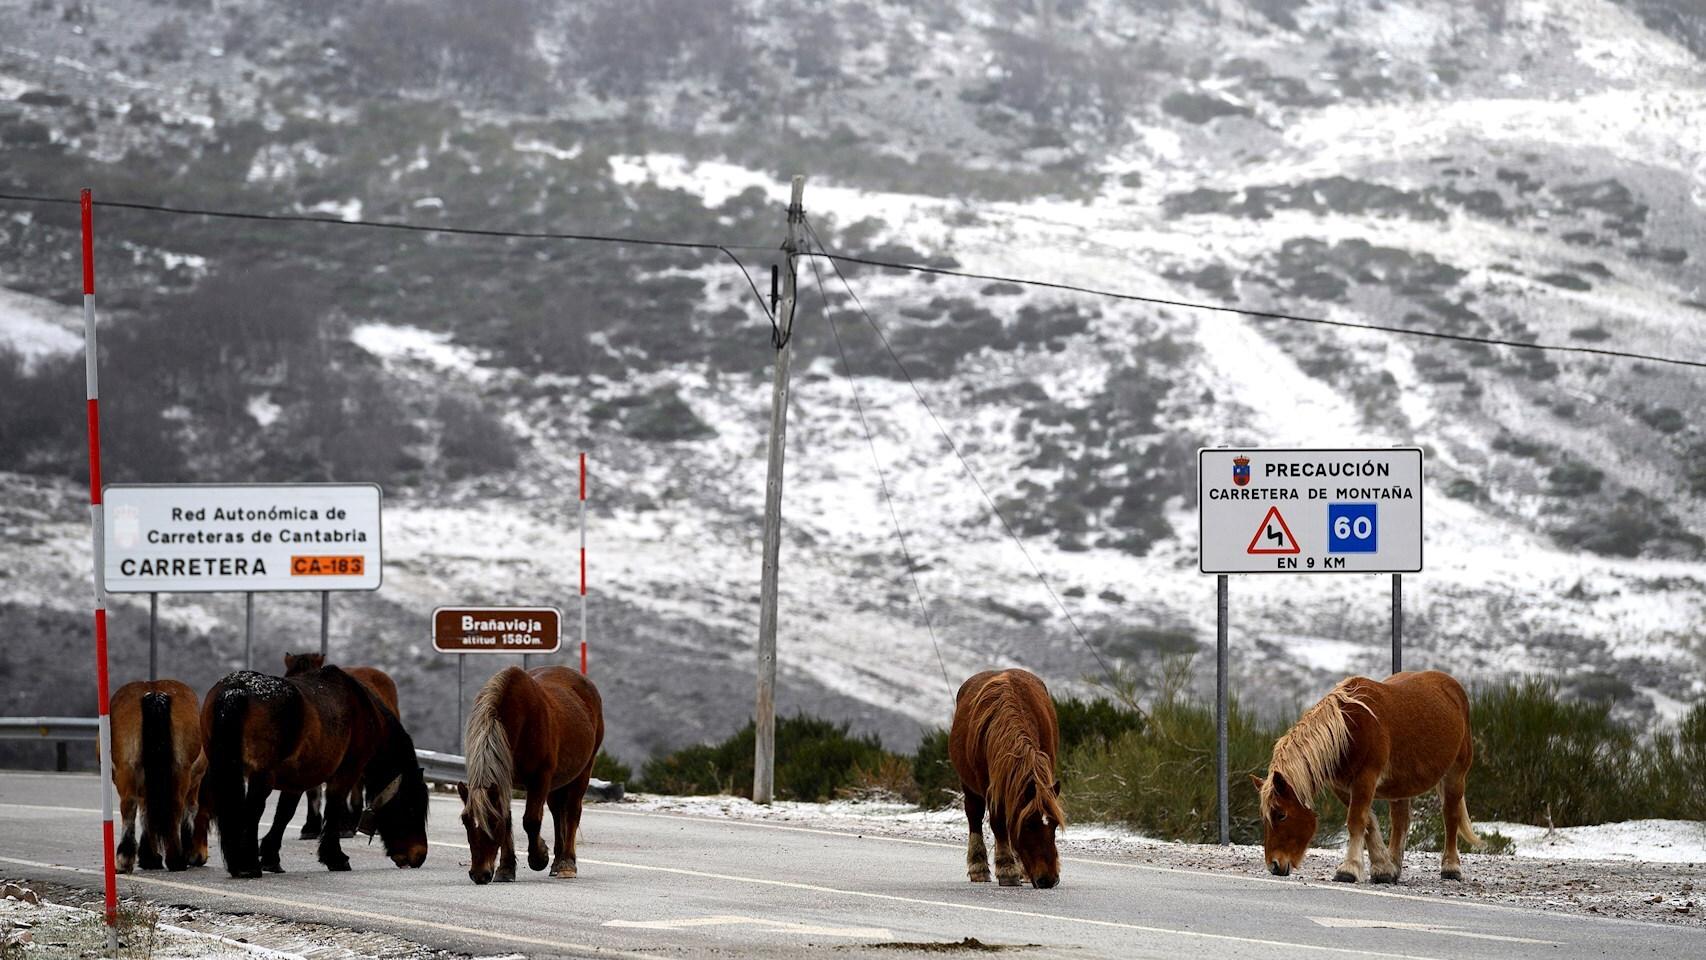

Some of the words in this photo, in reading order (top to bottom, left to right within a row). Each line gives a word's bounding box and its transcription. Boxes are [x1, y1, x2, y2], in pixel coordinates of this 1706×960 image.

[1265, 459, 1389, 477] PRECAUCIÓN
[1209, 488, 1299, 500] CARRETERA
[1308, 488, 1327, 499] DE
[1336, 485, 1413, 500] MONTAÑA
[172, 507, 206, 521] Red
[213, 506, 318, 521] Autonómica
[326, 506, 346, 520] de
[1334, 516, 1372, 540] 60
[147, 530, 244, 544] Carreteras
[251, 530, 272, 543] de
[279, 529, 367, 543] Cantabria
[120, 558, 267, 576] CARRETERA
[294, 558, 362, 574] CA-183
[1277, 557, 1297, 569] EN
[1306, 557, 1315, 569] 9
[1324, 557, 1346, 569] KM
[461, 615, 542, 633] Brañavieja
[462, 634, 496, 645] altitud
